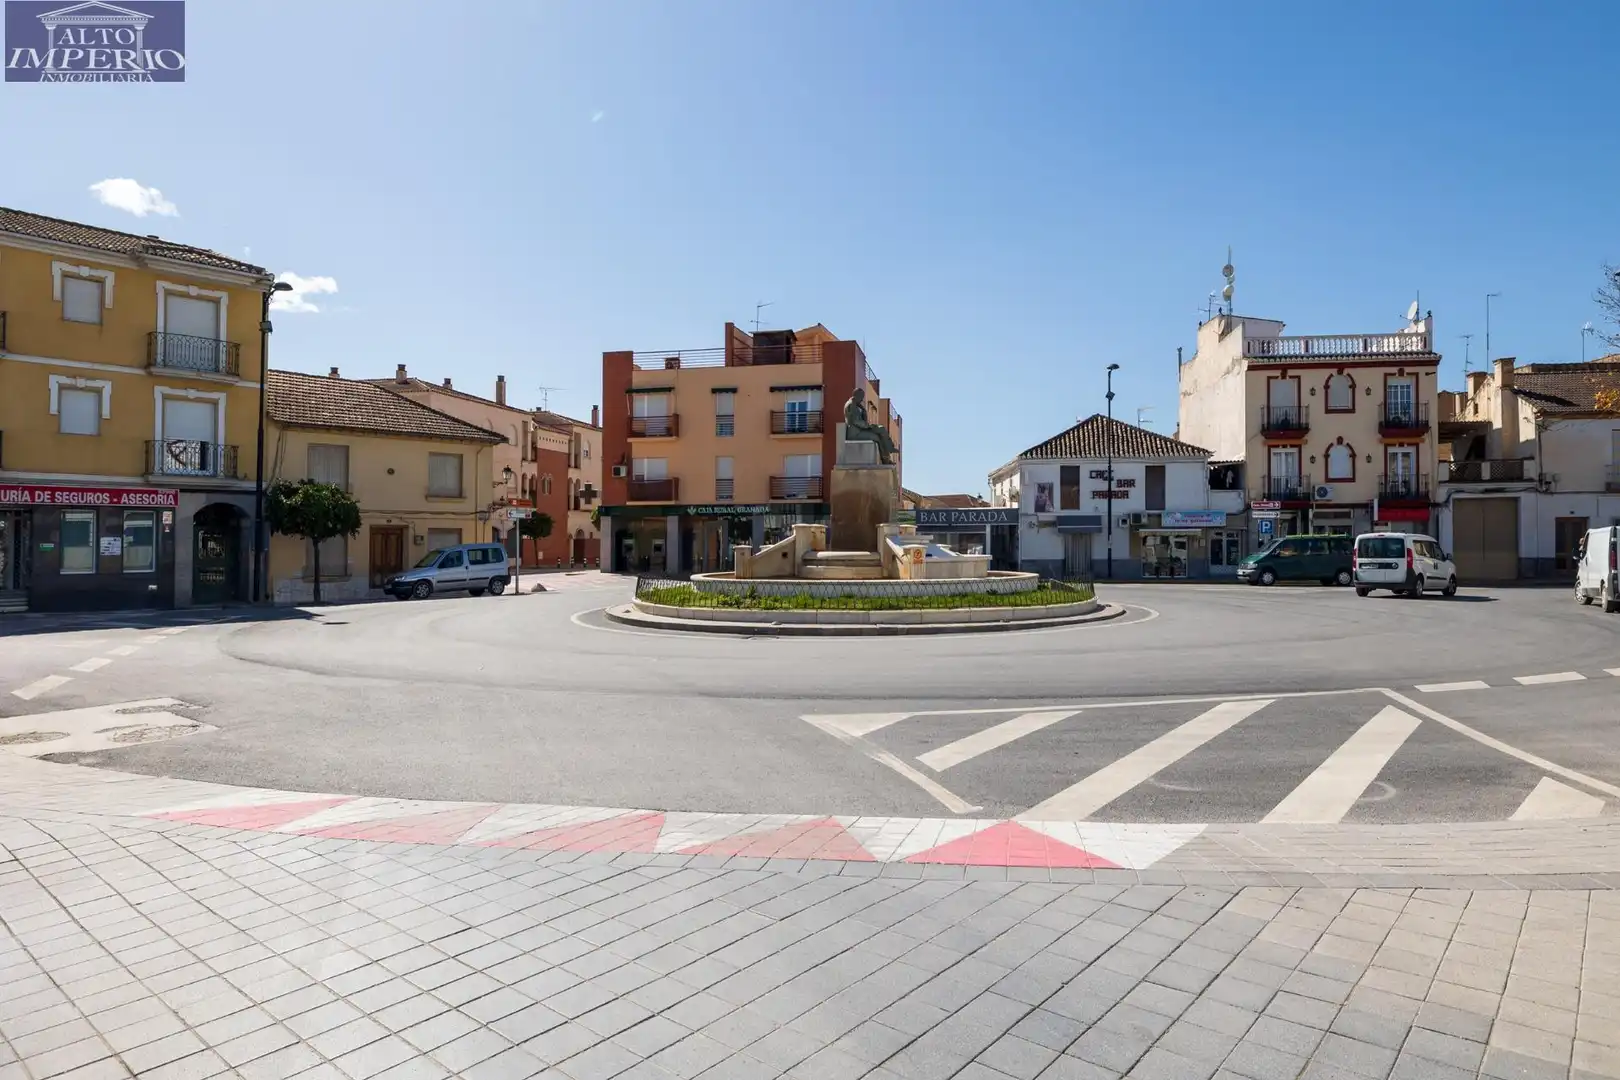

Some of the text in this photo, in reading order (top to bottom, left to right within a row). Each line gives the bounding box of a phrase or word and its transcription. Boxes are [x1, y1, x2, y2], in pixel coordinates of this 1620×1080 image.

[1116, 479, 1136, 488] BAR
[35, 490, 52, 503] DE
[54, 491, 110, 505] SEGUROS
[920, 511, 1008, 522] BAR PARADA
[1262, 521, 1271, 533] P
